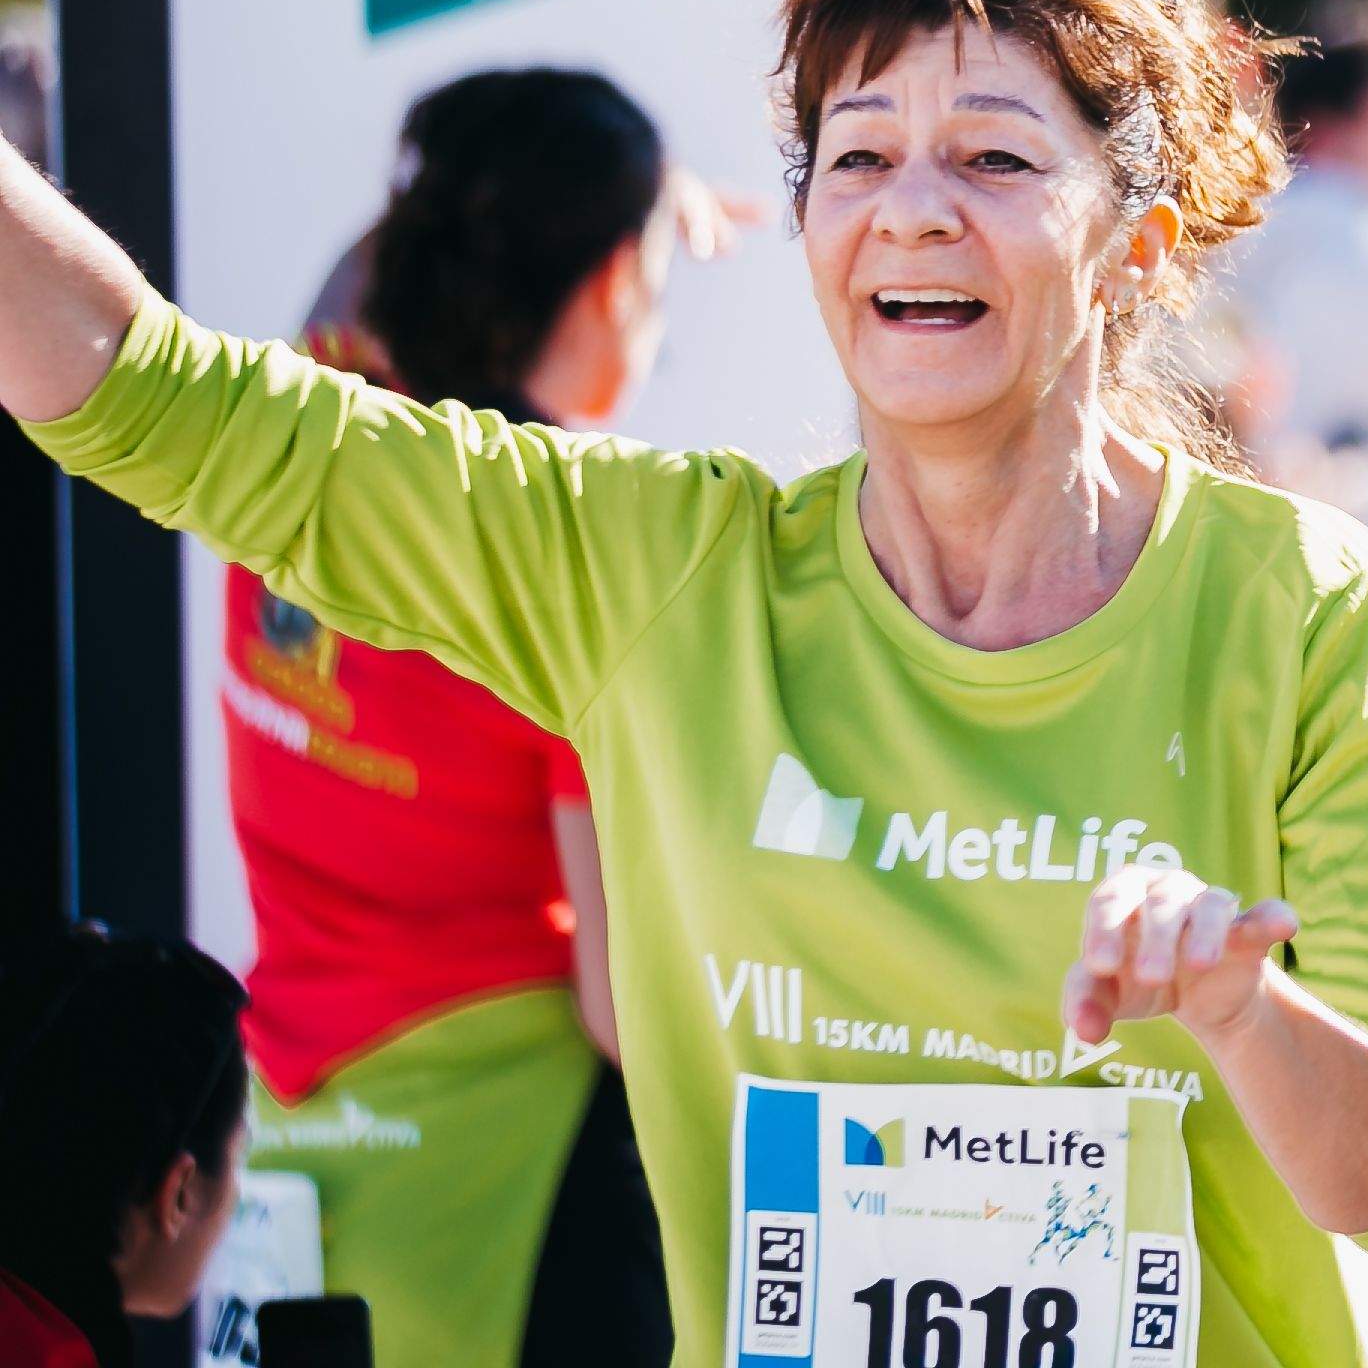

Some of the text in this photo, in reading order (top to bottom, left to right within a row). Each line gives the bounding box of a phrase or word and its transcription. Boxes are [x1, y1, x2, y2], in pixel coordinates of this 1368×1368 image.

[875, 810, 1186, 882] MetLife
[703, 953, 803, 1044] VIII
[812, 1017, 910, 1055] 15KM
[922, 1028, 1056, 1080] MADRID
[923, 1125, 1107, 1169] MetLife
[843, 1189, 886, 1217] VIII
[853, 1278, 1079, 1368] 1618
